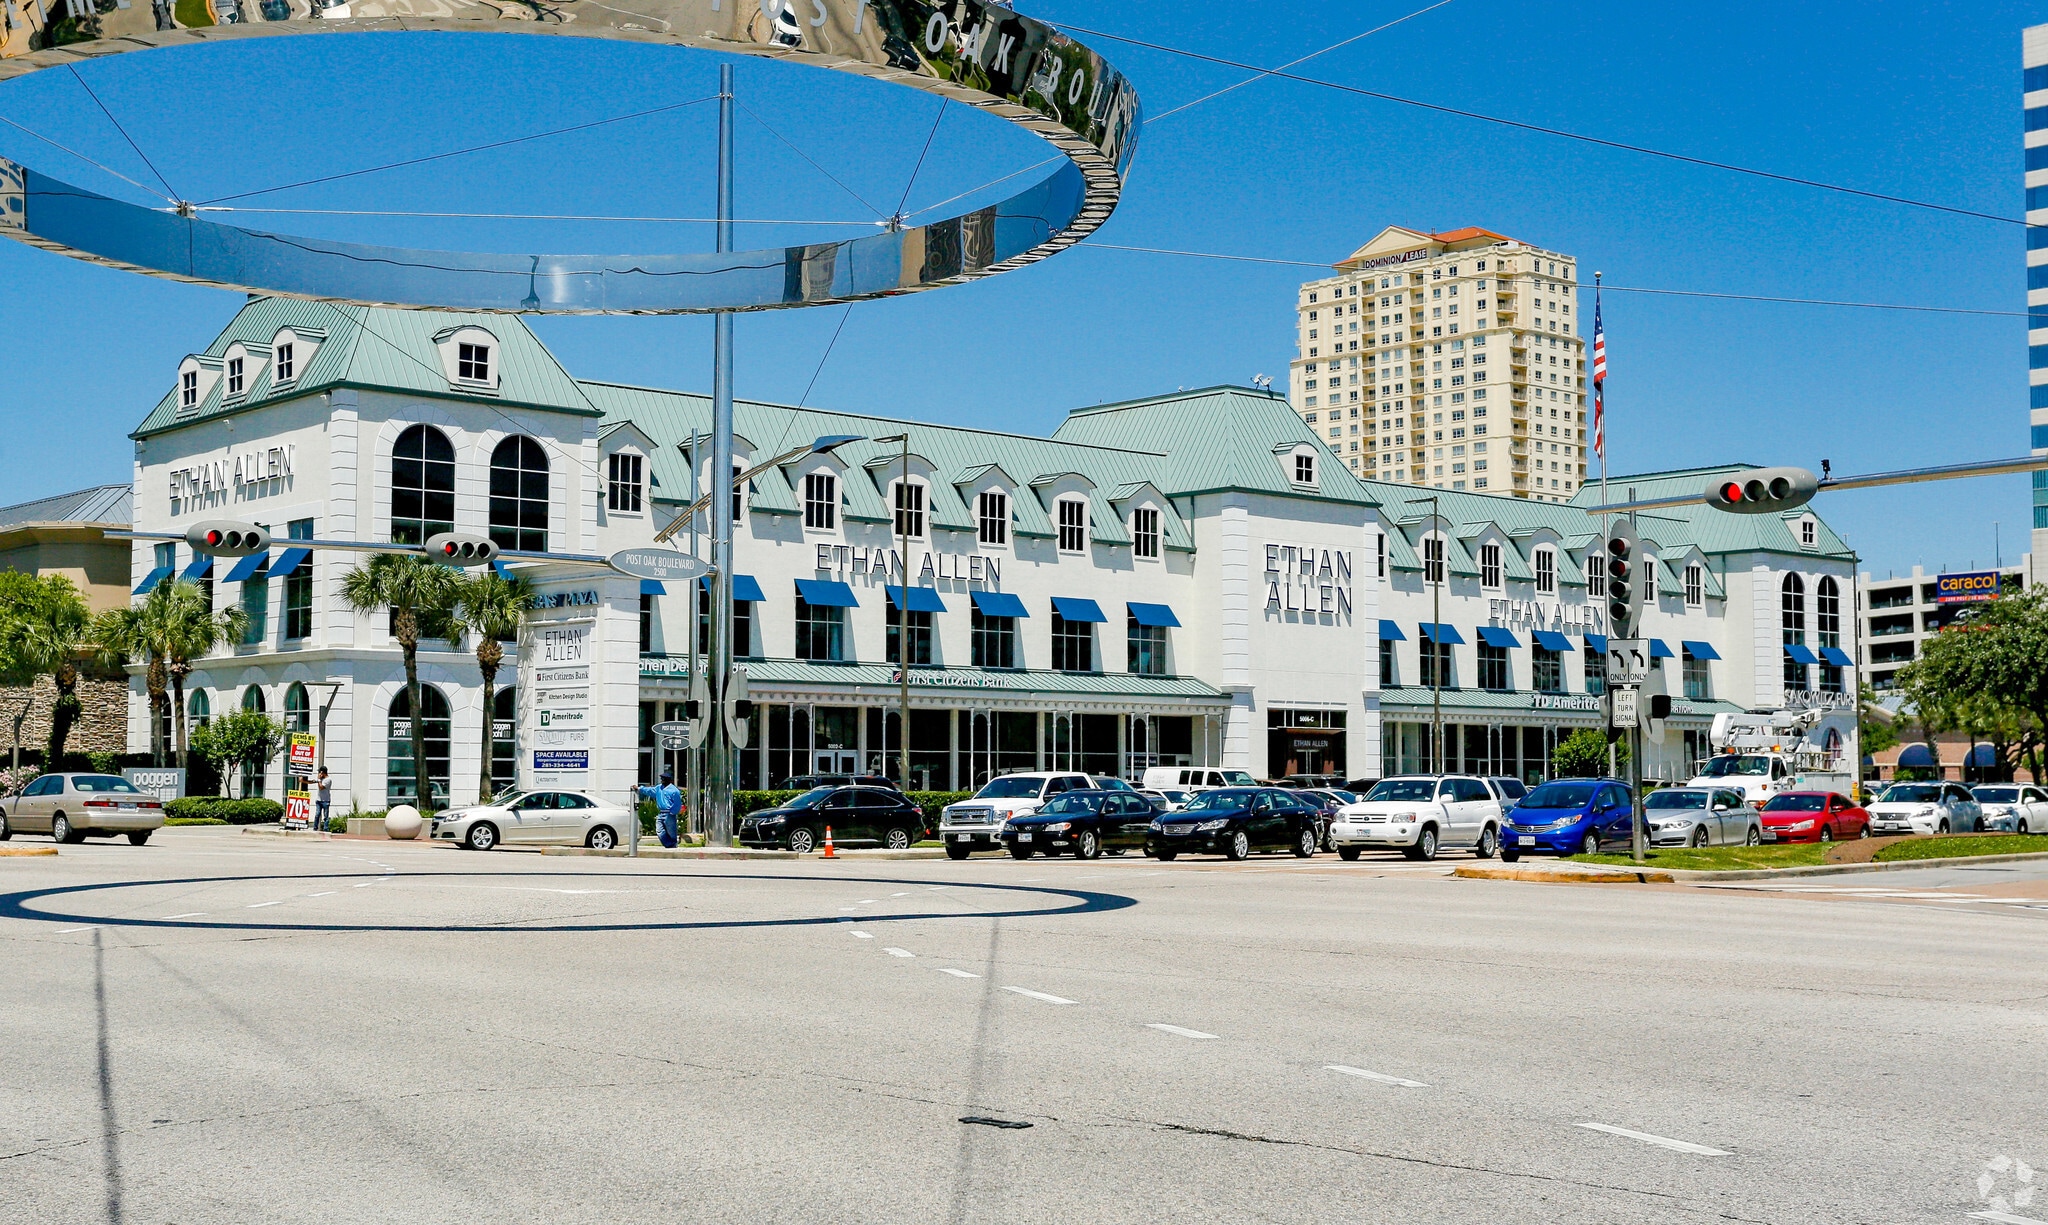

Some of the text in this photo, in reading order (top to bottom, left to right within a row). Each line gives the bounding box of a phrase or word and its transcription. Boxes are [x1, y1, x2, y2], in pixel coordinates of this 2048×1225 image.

[925, 12, 1016, 74] OAK
[1365, 249, 1427, 269] DOMINION LEASE
[170, 444, 295, 500] ETHAN ALLEN
[626, 553, 695, 570] POST OAK BOULEVARD
[919, 552, 1001, 582] ALLEN
[1265, 543, 1352, 579] ETHAN
[653, 568, 667, 577] 2500
[1940, 572, 1997, 591] caracol
[1265, 581, 1352, 615] ALLEN
[1490, 598, 1602, 627] ETHAN ALLEN
[545, 629, 582, 646] ETHAN
[544, 645, 582, 662] ALLEN
[542, 671, 589, 681] First Citizens Bank
[982, 675, 1010, 687] Bank
[1610, 673, 1628, 681] ONLY
[1532, 695, 1601, 710] TD Ameritra
[1617, 694, 1633, 702] LEFT
[1836, 692, 1855, 707] FURS
[1617, 704, 1634, 712] TURN
[1615, 714, 1635, 722] SIGNAL
[393, 721, 411, 731] pogge
[570, 732, 585, 741] FURS
[133, 772, 178, 787] poggen
